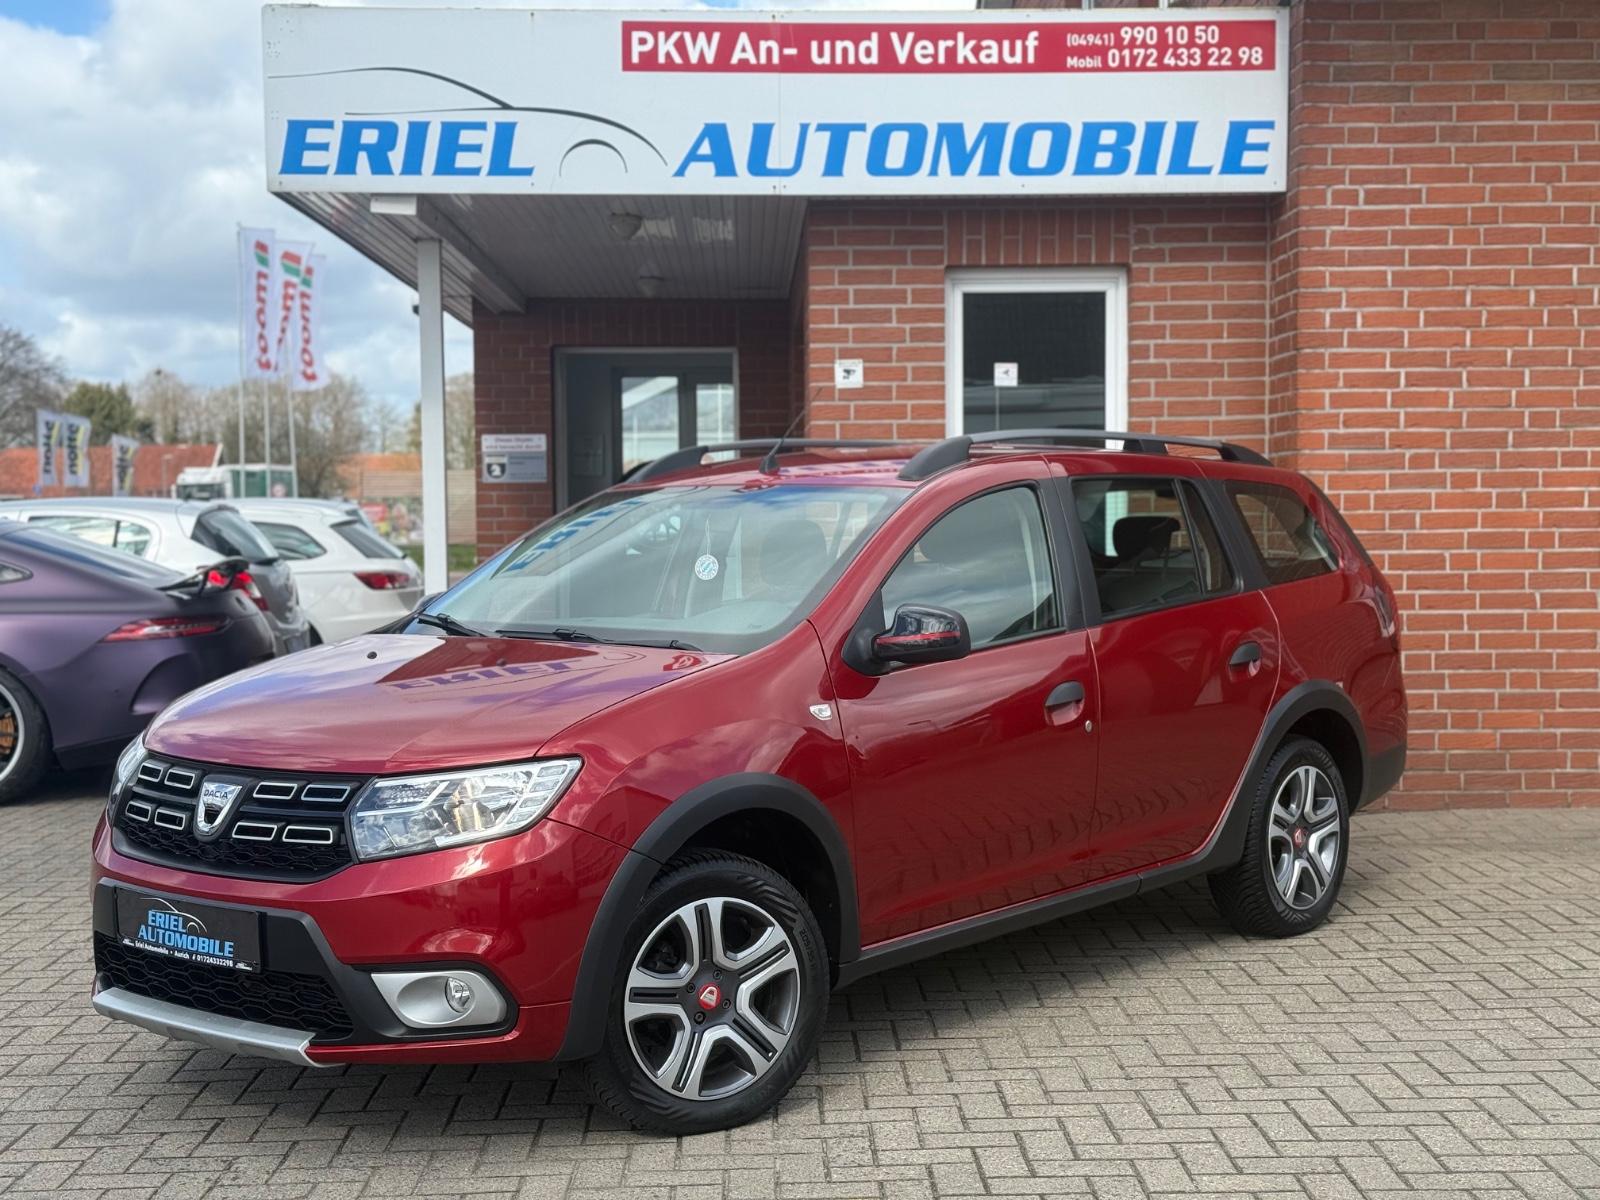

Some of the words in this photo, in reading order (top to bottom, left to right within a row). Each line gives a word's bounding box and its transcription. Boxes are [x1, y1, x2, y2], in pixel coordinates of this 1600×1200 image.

[630, 31, 720, 65] PKW
[731, 31, 797, 65] An-
[810, 31, 887, 66] und
[892, 30, 1040, 66] Verkauf
[1066, 32, 1115, 47] (04941)
[1120, 26, 1158, 45] 990
[1164, 26, 1188, 45] 10
[1194, 25, 1219, 44] 50
[1066, 56, 1102, 68] Mobil
[1107, 48, 1158, 67] 0172
[1163, 48, 1201, 67] 433
[1207, 48, 1232, 66] 22
[1238, 47, 1264, 66] 98
[279, 119, 535, 177] ERIEL
[671, 119, 1276, 179] AUTOMOBILE
[256, 270, 272, 370] toom
[67, 423, 79, 475] nolte
[203, 790, 229, 799] DACIA
[148, 909, 186, 933] ERIEL
[138, 925, 234, 958] AUTOMOBILE
